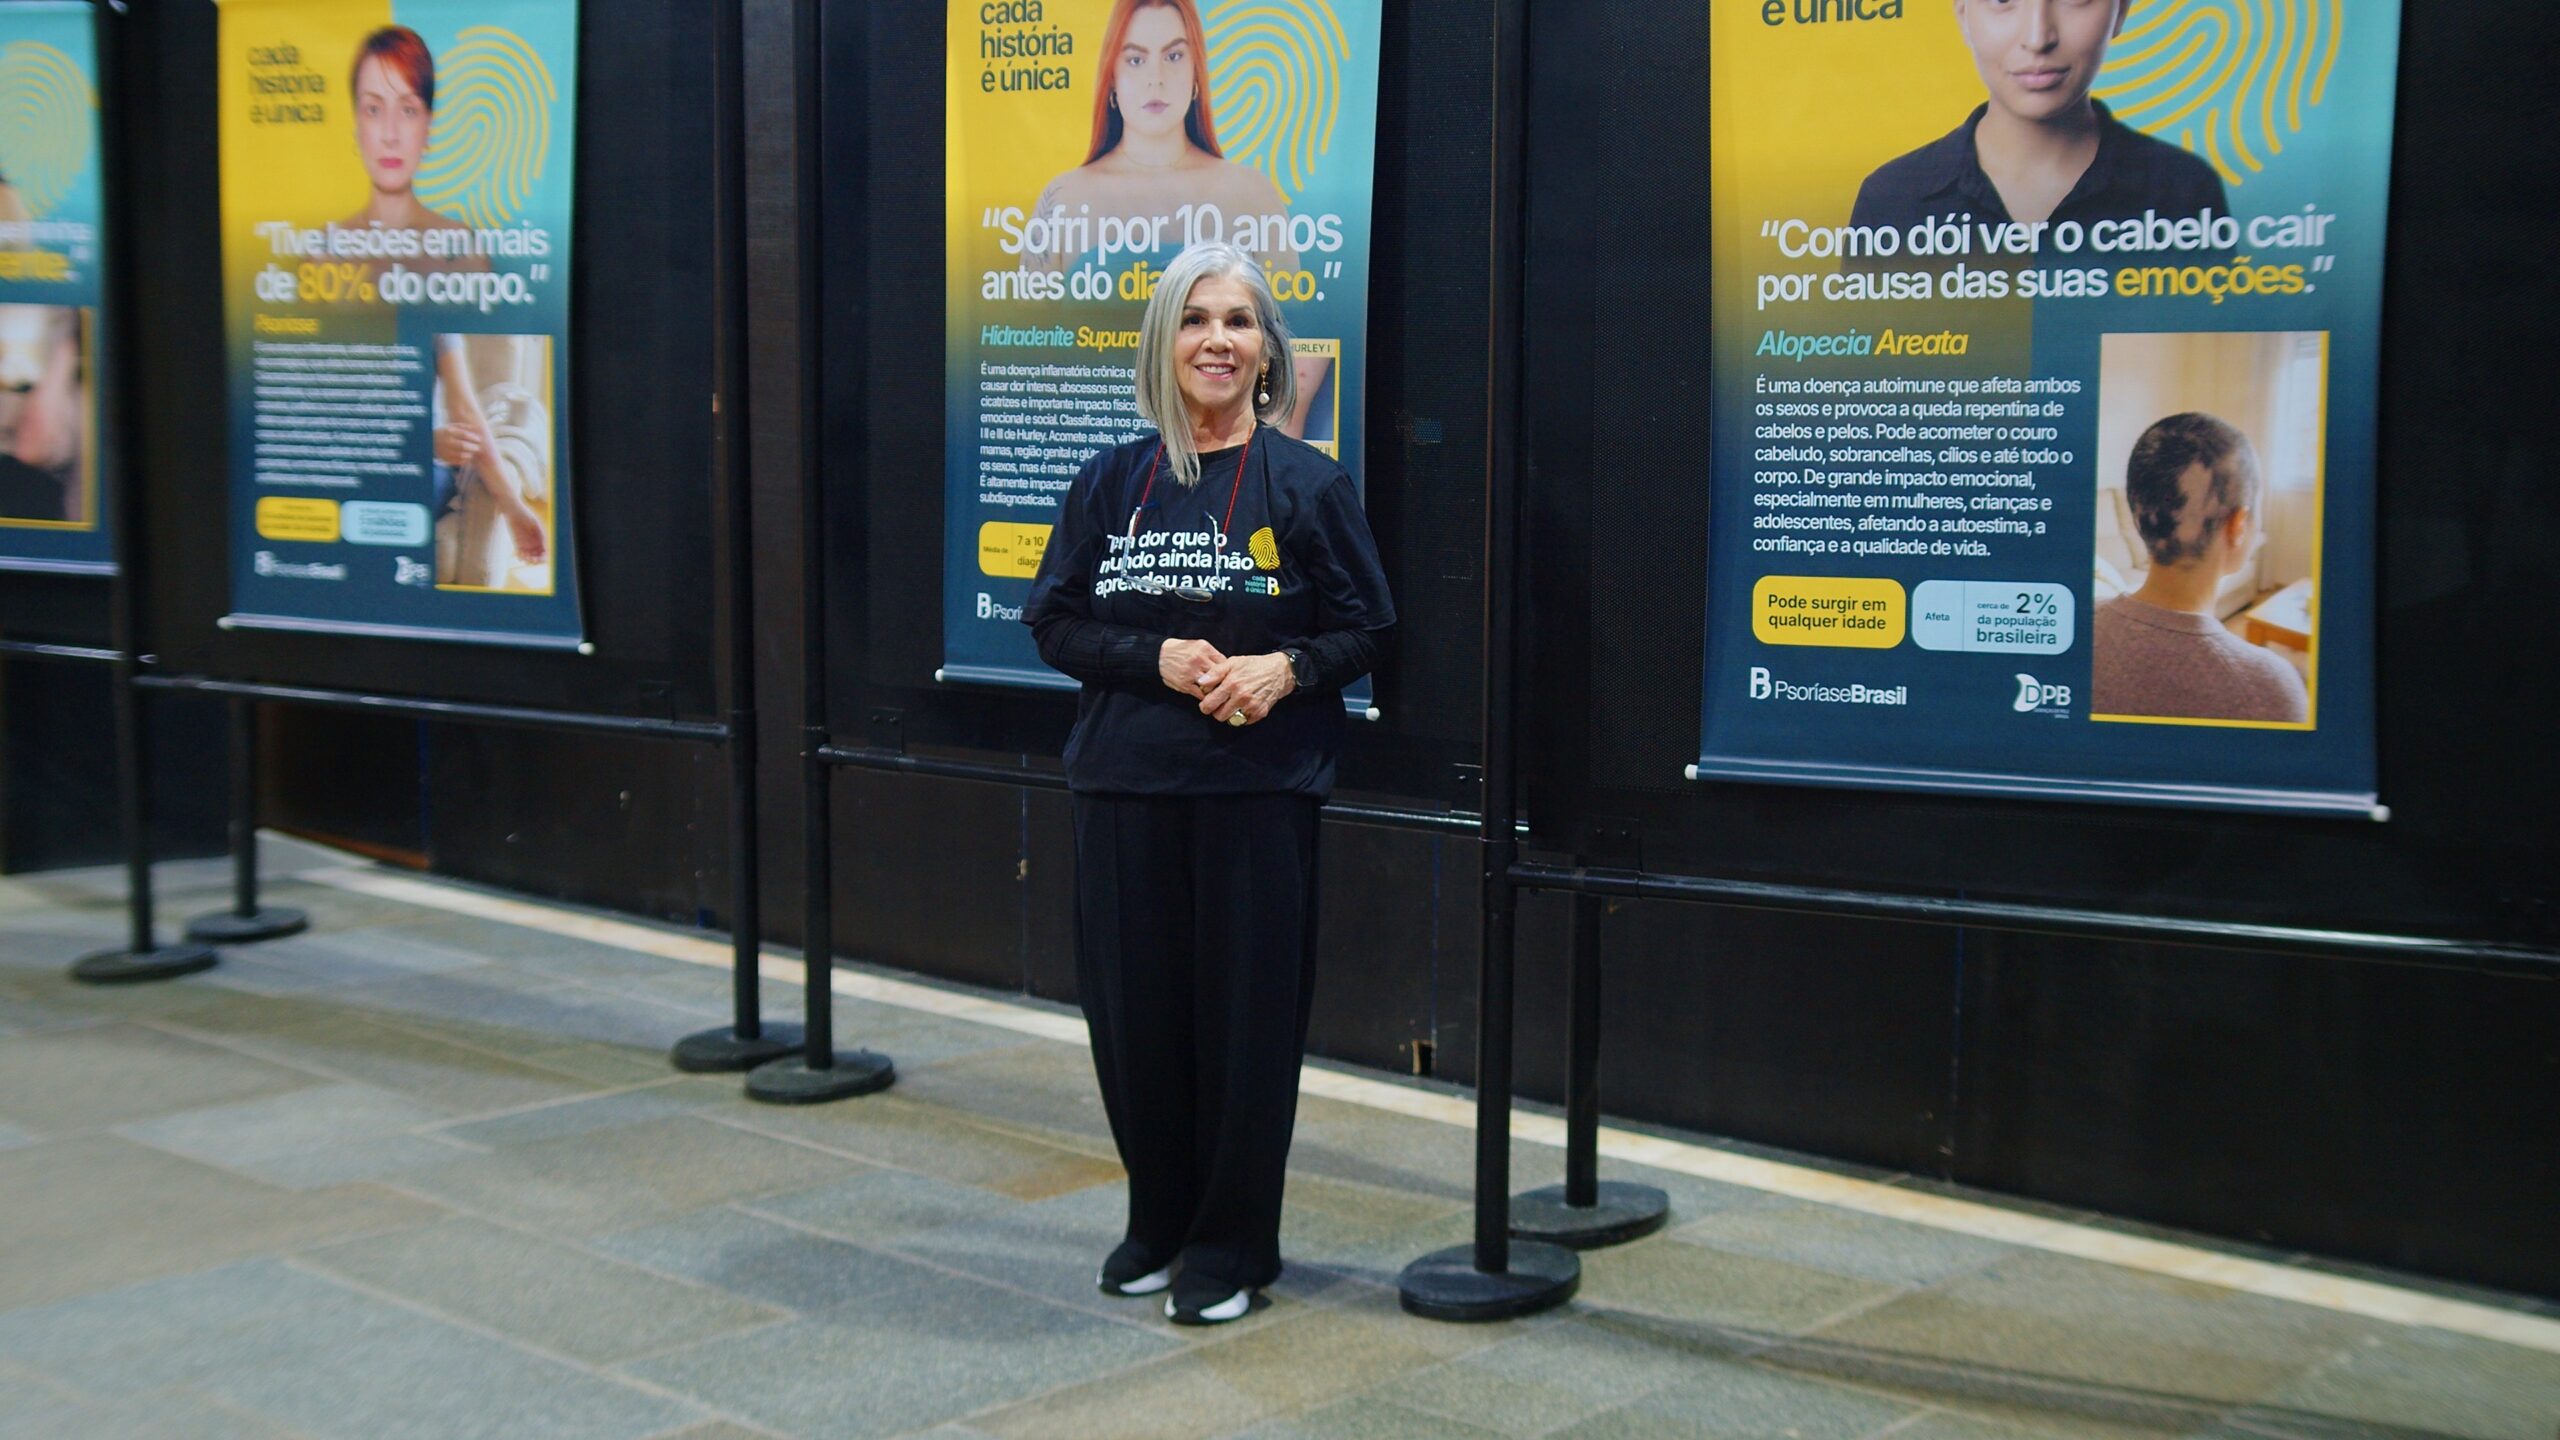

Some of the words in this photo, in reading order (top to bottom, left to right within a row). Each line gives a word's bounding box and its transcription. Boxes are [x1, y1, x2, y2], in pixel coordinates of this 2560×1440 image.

[981, 0, 1042, 24] cada
[980, 24, 1073, 58] história
[981, 61, 996, 92] é
[1000, 60, 1070, 91] única
[327, 220, 421, 257] lesões
[423, 229, 470, 257] em
[474, 219, 549, 257] mais
[1098, 214, 1169, 266] por
[1175, 203, 1224, 250] 10
[1231, 213, 1344, 253] anos
[1907, 212, 1971, 256] dói
[1978, 220, 2049, 255] ver
[2054, 219, 2084, 253] o
[2091, 207, 2241, 252] cabelo
[2248, 202, 2337, 248] cair
[255, 264, 297, 302] de
[298, 263, 376, 303] 80%
[378, 263, 424, 303] do
[980, 268, 1065, 301] antes
[1070, 263, 1113, 301] do
[1757, 271, 1818, 311] por
[1822, 268, 1933, 301] causa
[1940, 262, 2010, 300] das
[2016, 266, 2109, 298] suas
[980, 324, 1074, 348] Hidradenite
[1076, 325, 1141, 352] Supura
[1755, 328, 1872, 362] Alopecia
[1874, 328, 1969, 356] Areata
[980, 361, 987, 375] É
[988, 365, 1006, 376] uma
[1007, 363, 1040, 378] doença
[1041, 363, 1091, 378] inflamatória
[1092, 365, 1126, 379] crônica
[980, 380, 1009, 391] causar
[1009, 380, 1026, 391] dor
[1026, 381, 1059, 395] intensa,
[1059, 381, 1108, 394] abscessos
[1756, 373, 1767, 393] É
[1769, 380, 1801, 394] uma
[1803, 378, 1861, 397] doença
[1863, 377, 1946, 394] autoimune
[1948, 380, 1981, 397] que
[1982, 375, 2023, 394] afeta
[2025, 376, 2082, 394] ambos
[980, 395, 1021, 408] cicatrizes
[1021, 398, 1028, 408] e
[1028, 395, 1074, 411] importante
[1074, 397, 1112, 412] impacto
[1755, 403, 1774, 417] os
[1776, 403, 1820, 417] sexos
[1822, 403, 1833, 417] e
[1834, 402, 1897, 420] provoca
[1899, 403, 1910, 417] a
[1912, 401, 1962, 420] queda
[1965, 400, 2040, 420] repentina
[2042, 400, 2065, 417] de
[980, 411, 1024, 424] emocional
[1024, 414, 1031, 424] e
[1059, 413, 1113, 427] Classificada
[1113, 417, 1131, 428] nos
[1004, 429, 1016, 440] de
[1016, 429, 1048, 444] Hurley.
[1049, 430, 1088, 443] Acomete
[1088, 432, 1116, 446] axilas,
[1755, 423, 1813, 440] cabelos
[1815, 426, 1826, 440] e
[1827, 424, 1873, 443] pelos.
[1875, 423, 1917, 440] Pode
[1918, 425, 1995, 440] acometer
[1996, 426, 2007, 440] o
[2009, 426, 2058, 440] couro
[980, 446, 1013, 459] mamas,
[1014, 445, 1042, 459] região
[1043, 445, 1071, 459] genital
[1071, 450, 1078, 459] e
[1754, 446, 1827, 465] cabeludo,
[1829, 446, 1936, 465] sobrancelhas,
[1938, 446, 1978, 464] cílios
[1980, 450, 1992, 464] e
[1993, 446, 2020, 464] até
[2021, 447, 2060, 464] todo
[2061, 451, 2074, 465] o
[980, 461, 991, 472] os
[991, 462, 1018, 475] sexos,
[1019, 463, 1039, 473] mas
[1047, 462, 1068, 474] mais
[979, 473, 987, 487] É
[986, 476, 1028, 489] altamente
[1753, 471, 1802, 488] corpo.
[1803, 468, 1826, 485] De
[1827, 469, 1883, 489] grande
[1884, 469, 1948, 490] impacto
[1949, 470, 2037, 491] emocional,
[979, 493, 1057, 508] subdiagnosticada.
[1753, 491, 1862, 511] especialmente
[1863, 495, 1890, 509] em
[1891, 493, 1968, 513] mulheres,
[1970, 496, 2039, 515] crianças
[2040, 497, 2053, 512] e
[1753, 513, 1856, 534] adolescentes,
[1857, 514, 1927, 533] afetando
[1928, 519, 1939, 532] a
[1941, 517, 2033, 537] autoestima,
[2034, 520, 2046, 535] a
[1017, 535, 1023, 546] 7
[1033, 536, 1044, 547] 10
[1138, 529, 1170, 548] dor
[1172, 531, 1211, 549] que
[1213, 533, 1228, 547] o
[1753, 535, 1826, 556] confiança
[1827, 539, 1838, 553] e
[1840, 539, 1851, 553] a
[1852, 538, 1929, 558] qualidade
[1930, 538, 1951, 555] de
[1953, 540, 1991, 557] vida.
[1158, 549, 1217, 568] ainda
[1216, 552, 1255, 570] não
[1768, 593, 1807, 609] Pode
[1810, 596, 1859, 614] surgir
[1861, 598, 1887, 612] em
[2000, 602, 2010, 610] de
[2015, 591, 2058, 616] 2%
[1768, 612, 1839, 631] qualquer
[1841, 613, 1887, 630] idade
[1924, 611, 1951, 622] Afeta
[1976, 613, 1992, 626] da
[1993, 614, 2058, 629] população
[1976, 626, 2058, 645] brasileira
[2018, 677, 2071, 709] DPB
